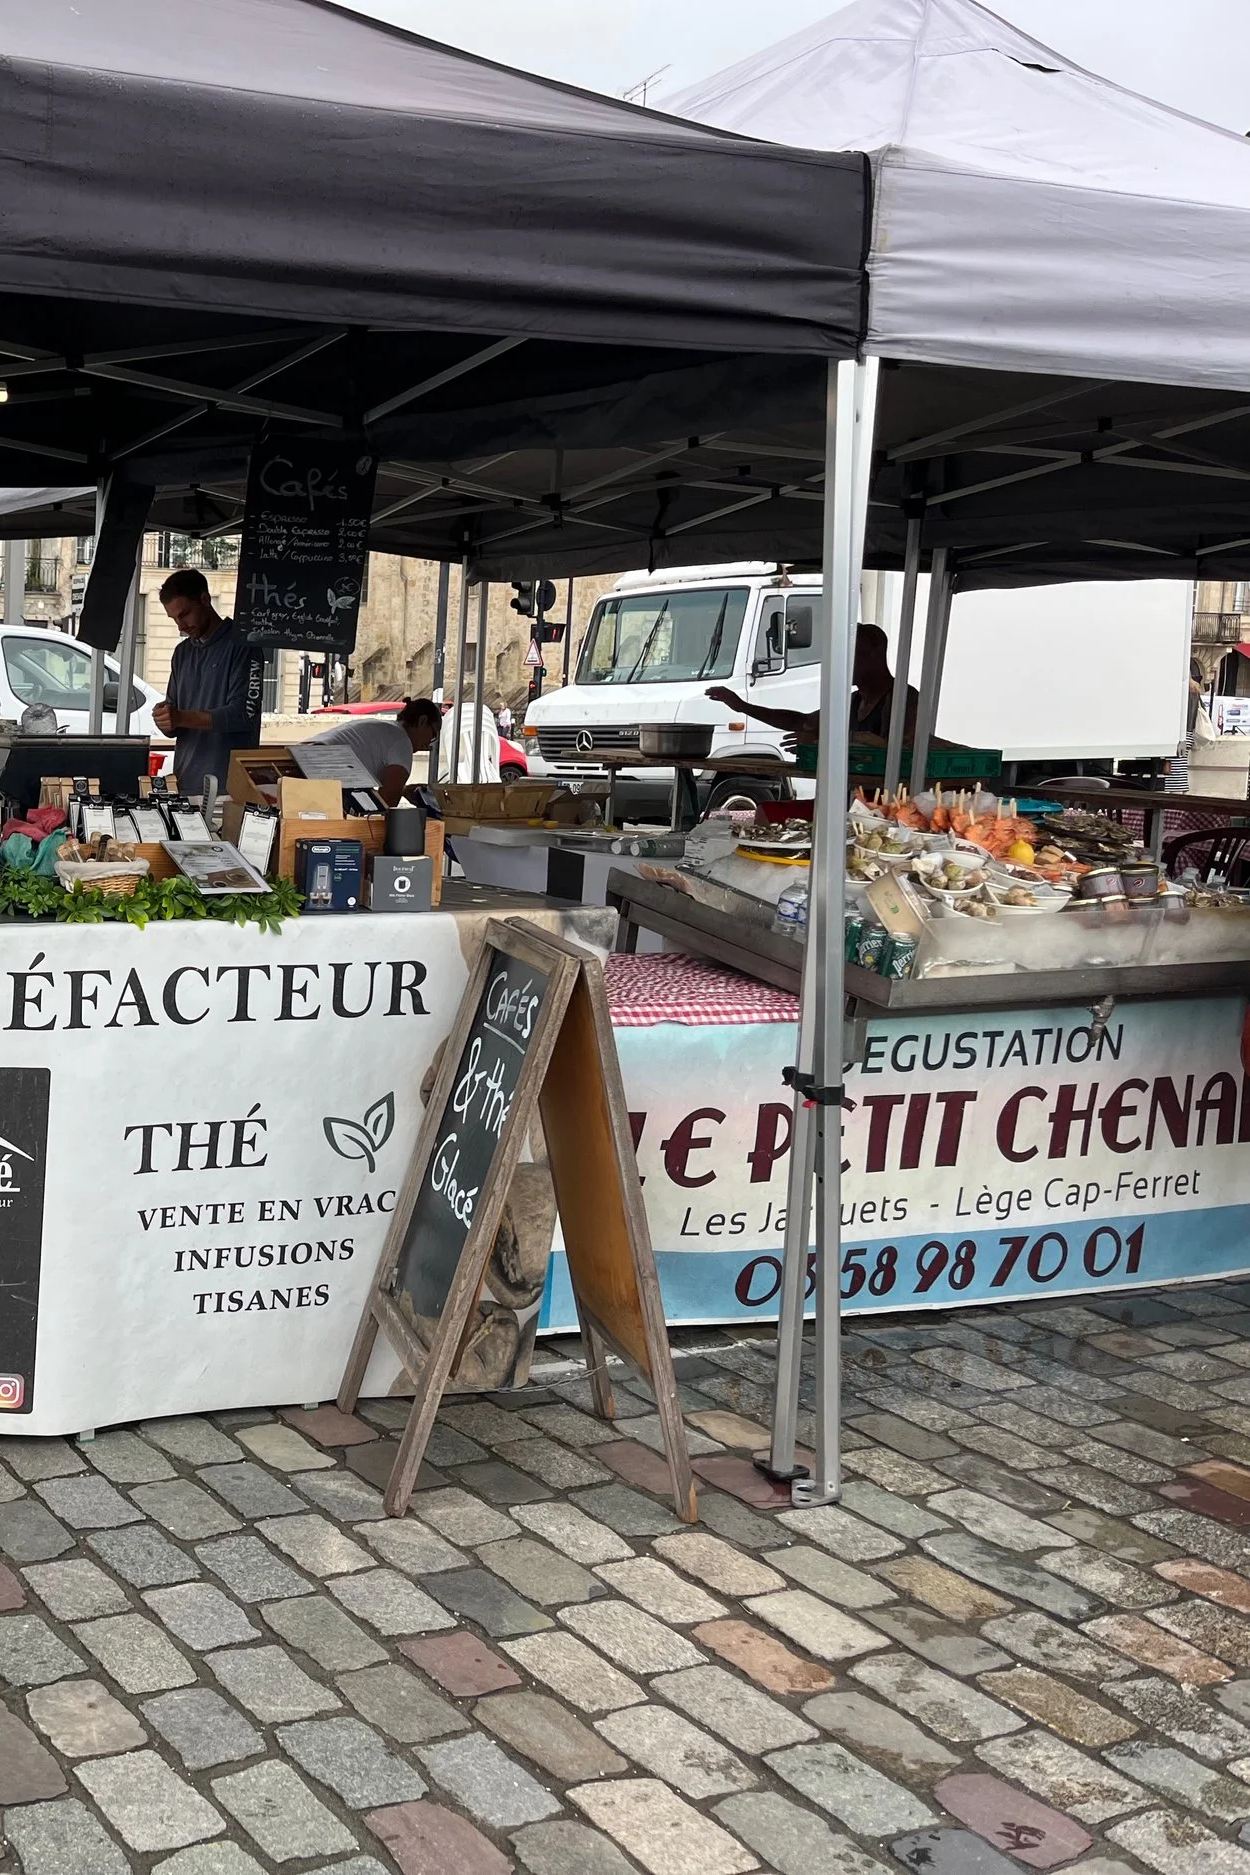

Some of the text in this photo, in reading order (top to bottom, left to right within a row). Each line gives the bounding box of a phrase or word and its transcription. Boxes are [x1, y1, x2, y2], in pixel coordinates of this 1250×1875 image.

[260, 455, 348, 511] Cafés
[248, 659, 261, 700] CREW
[843, 1024, 1124, 1074] EGUSTATION
[124, 1103, 268, 1175] THÉ
[747, 1091, 978, 1184] PTIT
[138, 1191, 396, 1231] VENTE EN VRAC
[680, 1207, 747, 1236] Les
[758, 1195, 908, 1235] Jauets
[956, 1184, 1032, 1220] Lège
[1045, 1169, 1200, 1212] Cap-Ferret
[174, 1239, 354, 1272] INFUSIONS
[840, 1246, 898, 1300] 58
[913, 1239, 977, 1293] 98
[990, 1231, 1068, 1288] 70
[1083, 1222, 1146, 1278] 01
[193, 1284, 330, 1314] TISANES
